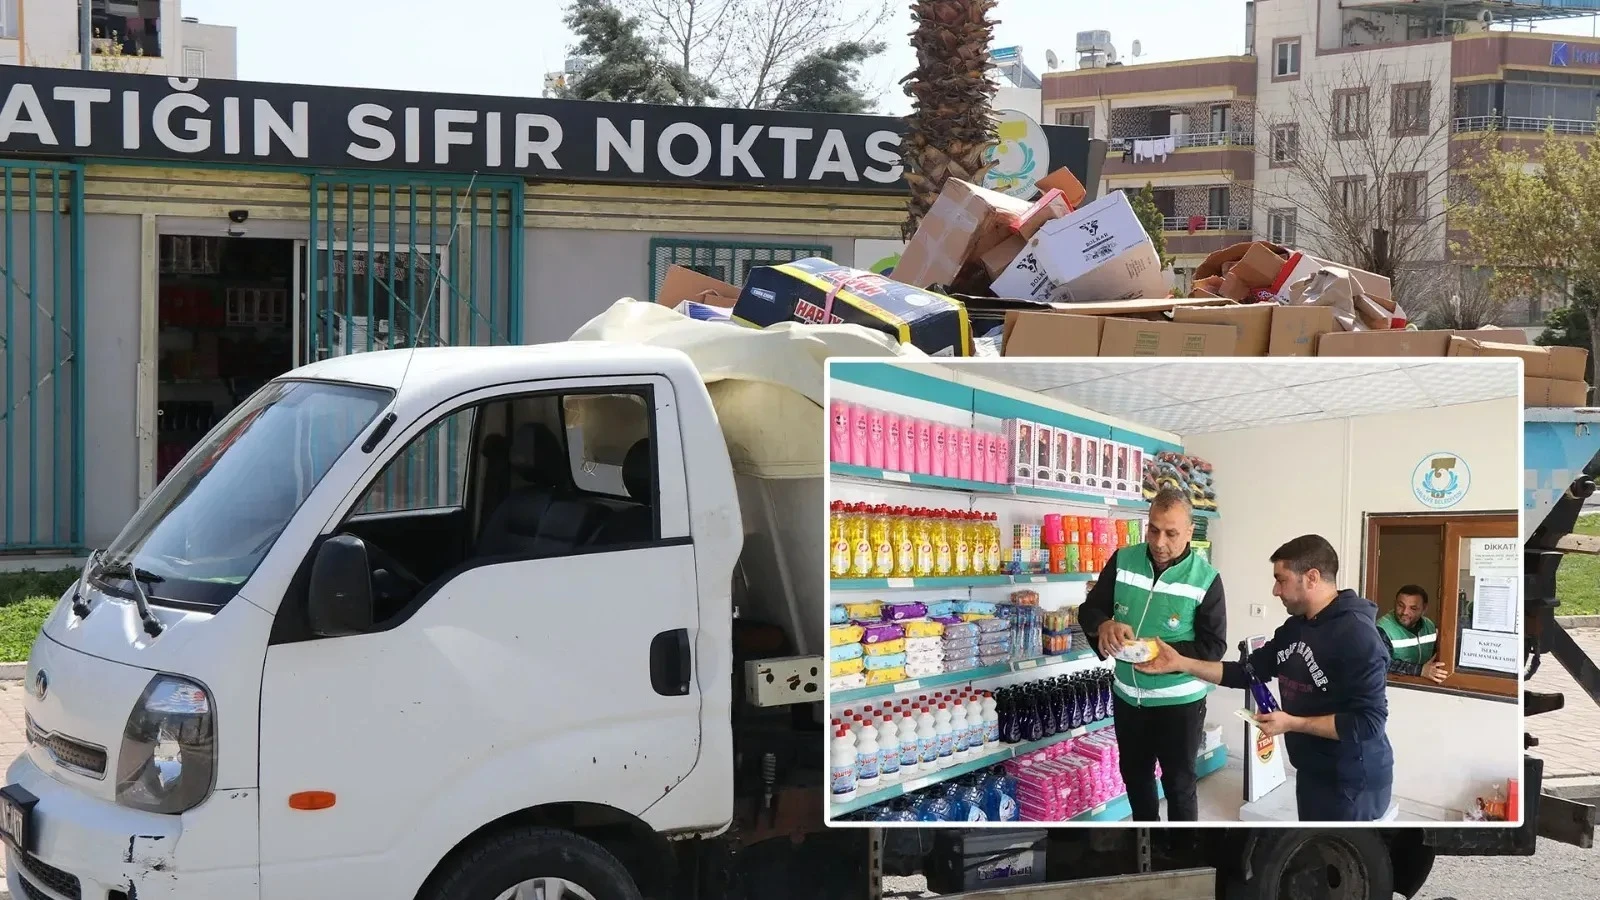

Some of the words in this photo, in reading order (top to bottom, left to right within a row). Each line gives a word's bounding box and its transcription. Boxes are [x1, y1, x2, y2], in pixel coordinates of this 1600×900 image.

[0, 77, 309, 158] ATIĞIN
[346, 103, 563, 171] SIFIR
[796, 300, 842, 325] HAPY
